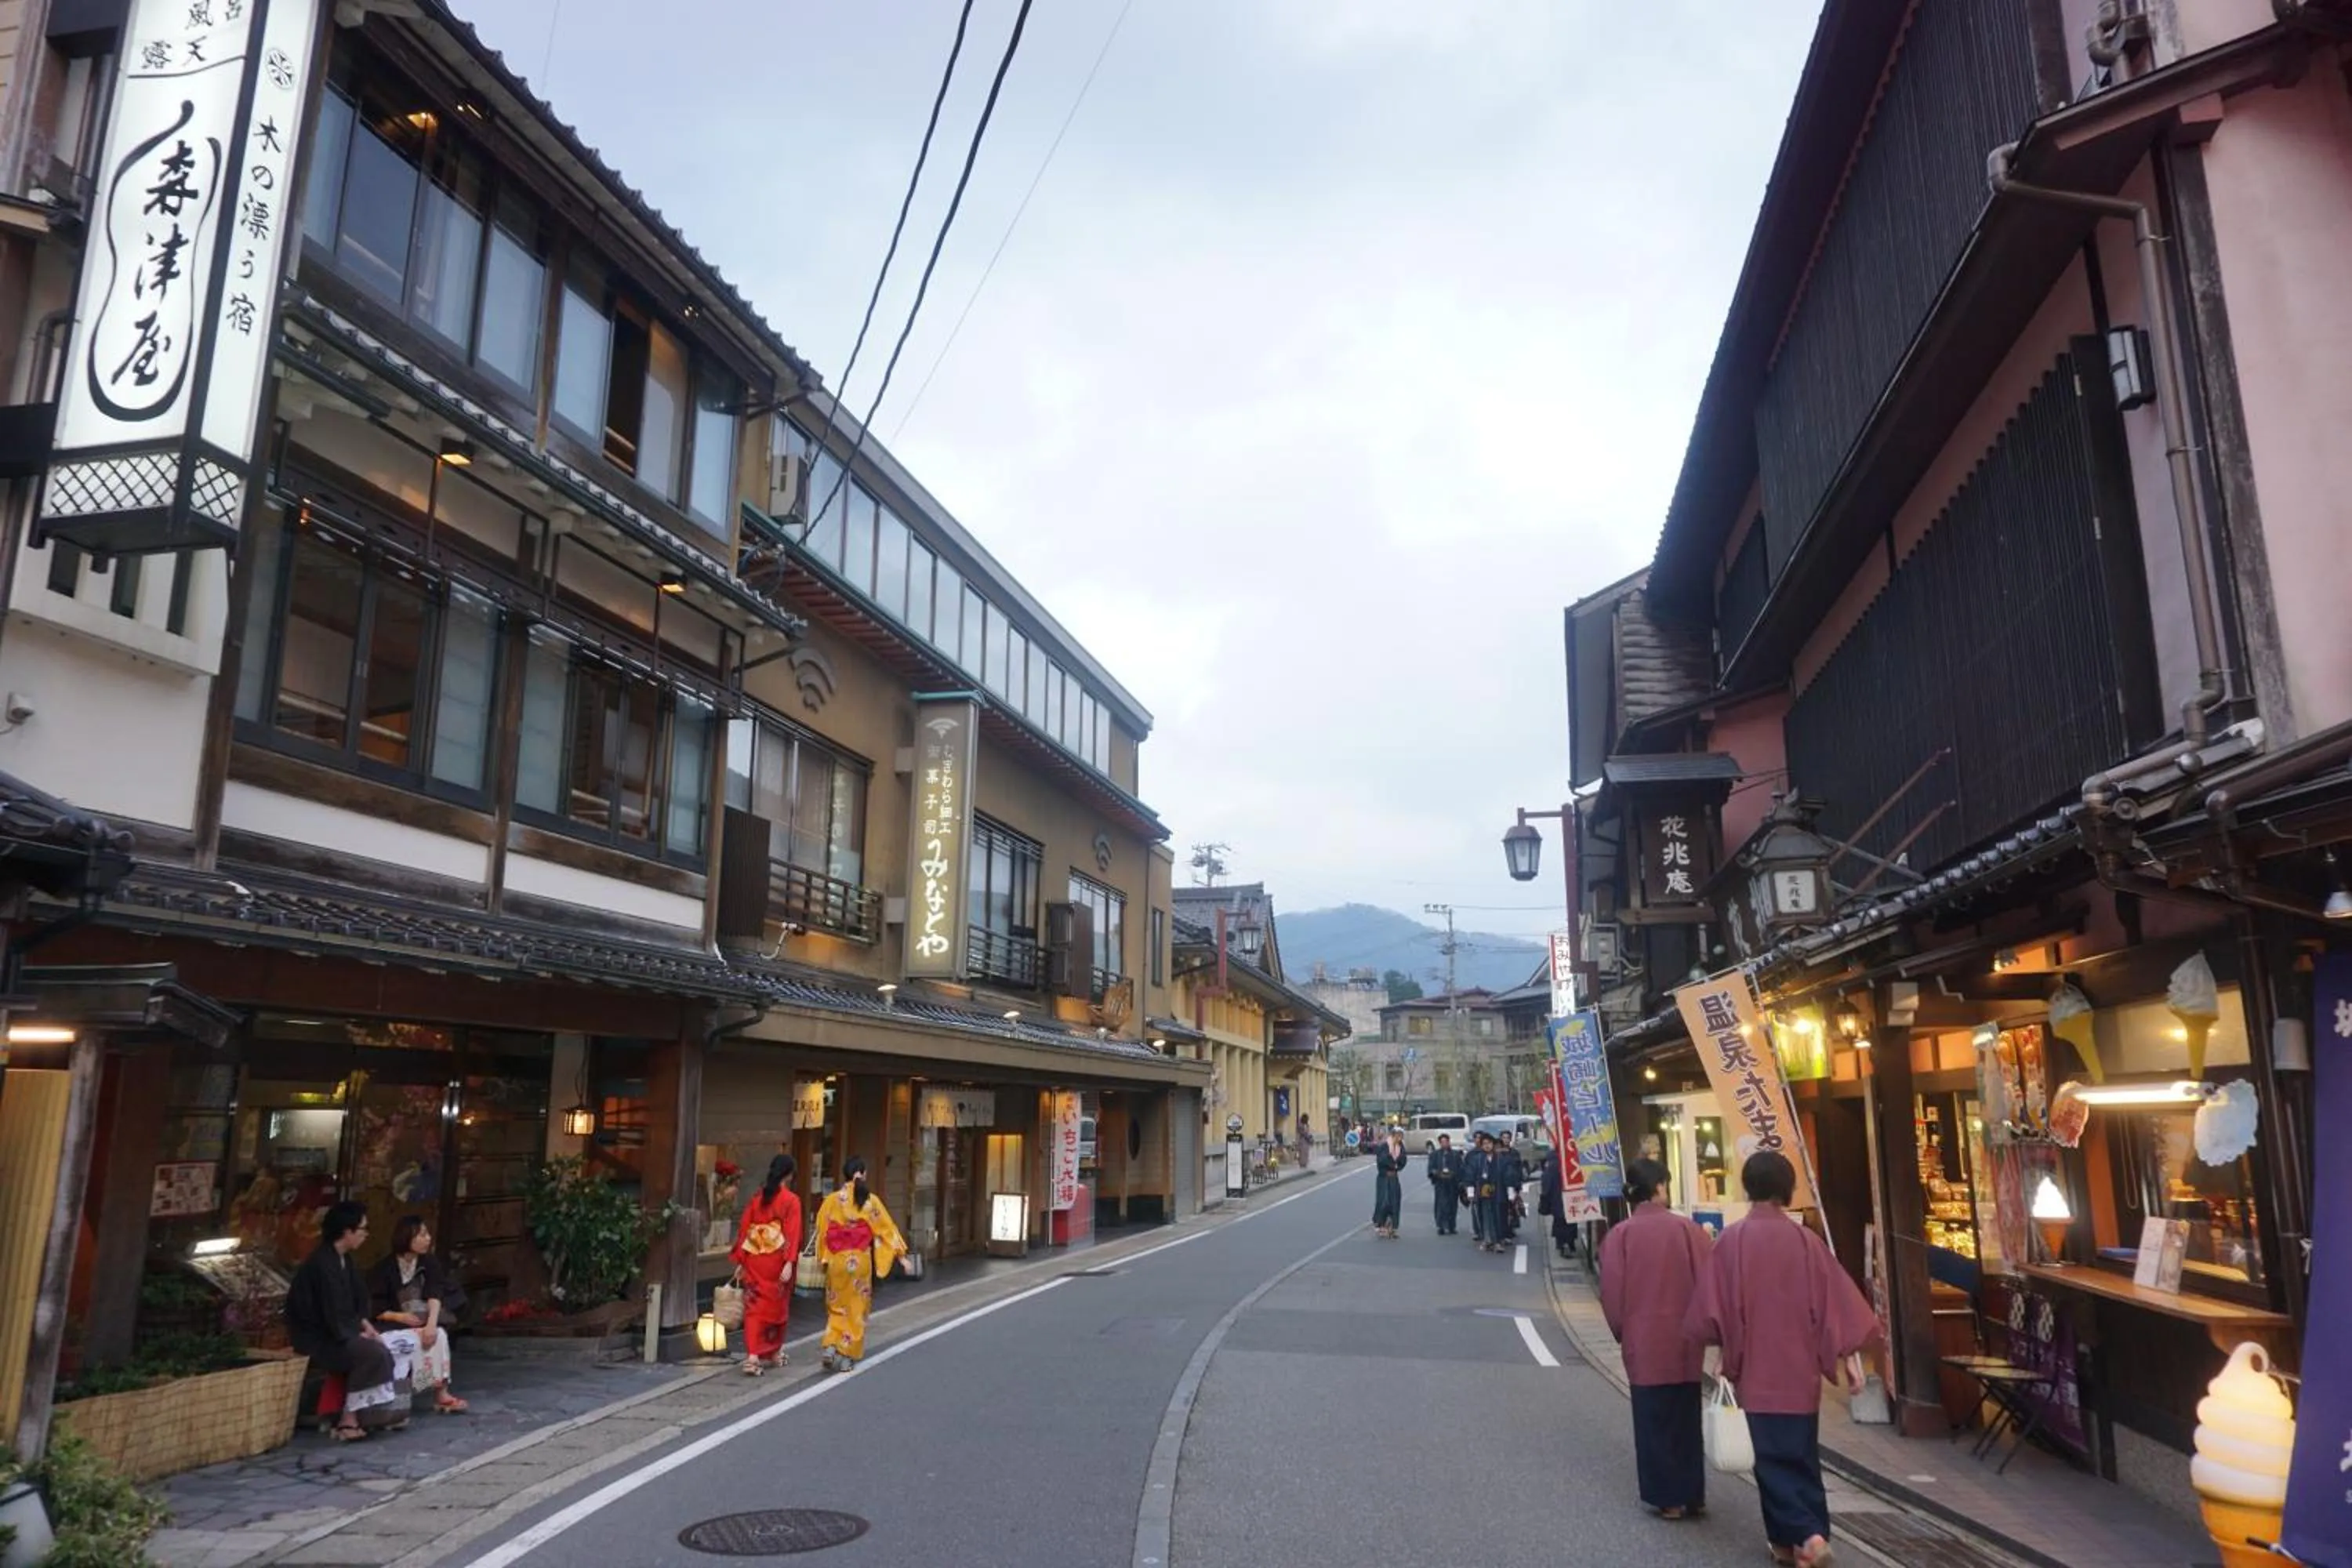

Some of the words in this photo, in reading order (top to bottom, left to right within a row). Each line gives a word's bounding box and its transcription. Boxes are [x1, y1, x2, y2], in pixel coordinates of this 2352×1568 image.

[111, 140, 199, 387] 森津屋
[227, 114, 281, 336] 木の漂う宿
[1660, 815, 1694, 895] 花兆庵
